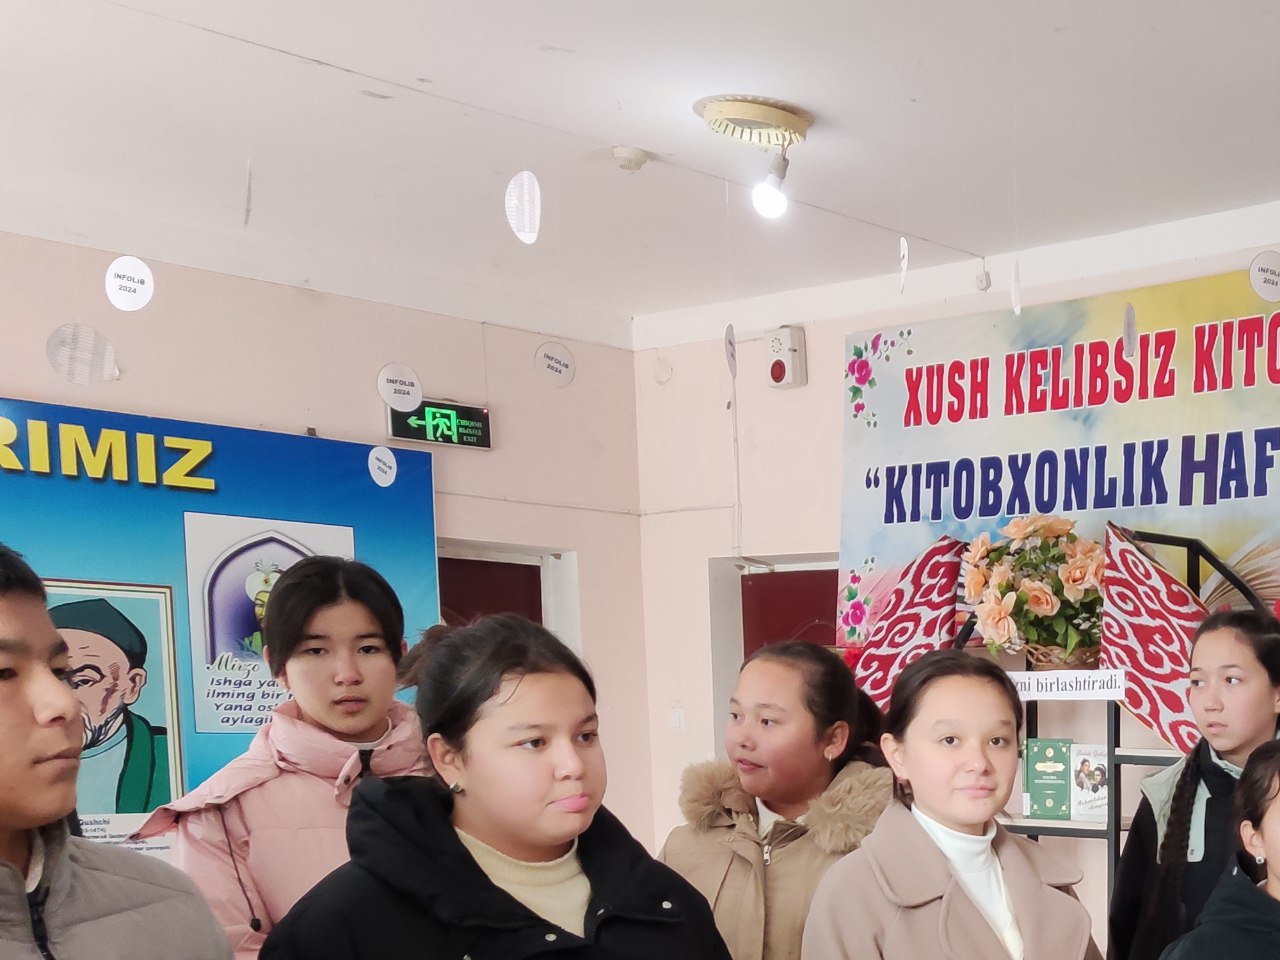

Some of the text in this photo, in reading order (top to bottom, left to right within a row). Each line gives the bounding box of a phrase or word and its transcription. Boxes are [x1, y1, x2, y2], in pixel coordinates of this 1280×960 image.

[113, 272, 145, 285] INFOLIB
[1262, 277, 1279, 287] 2024
[118, 284, 137, 294] 2024
[543, 352, 569, 369] INFOLIB
[546, 363, 562, 374] 2024
[386, 378, 415, 388] INFOLIB
[904, 357, 990, 427] XUSH
[1004, 330, 1177, 416] KELIBSIZ
[393, 388, 411, 396] 2024
[206, 653, 260, 679] Mirzo
[210, 677, 252, 689] Ishga
[1036, 673, 1121, 693] birlashtiradi.
[206, 689, 256, 702] ilming
[261, 690, 284, 700] bir
[214, 703, 253, 711] Yana
